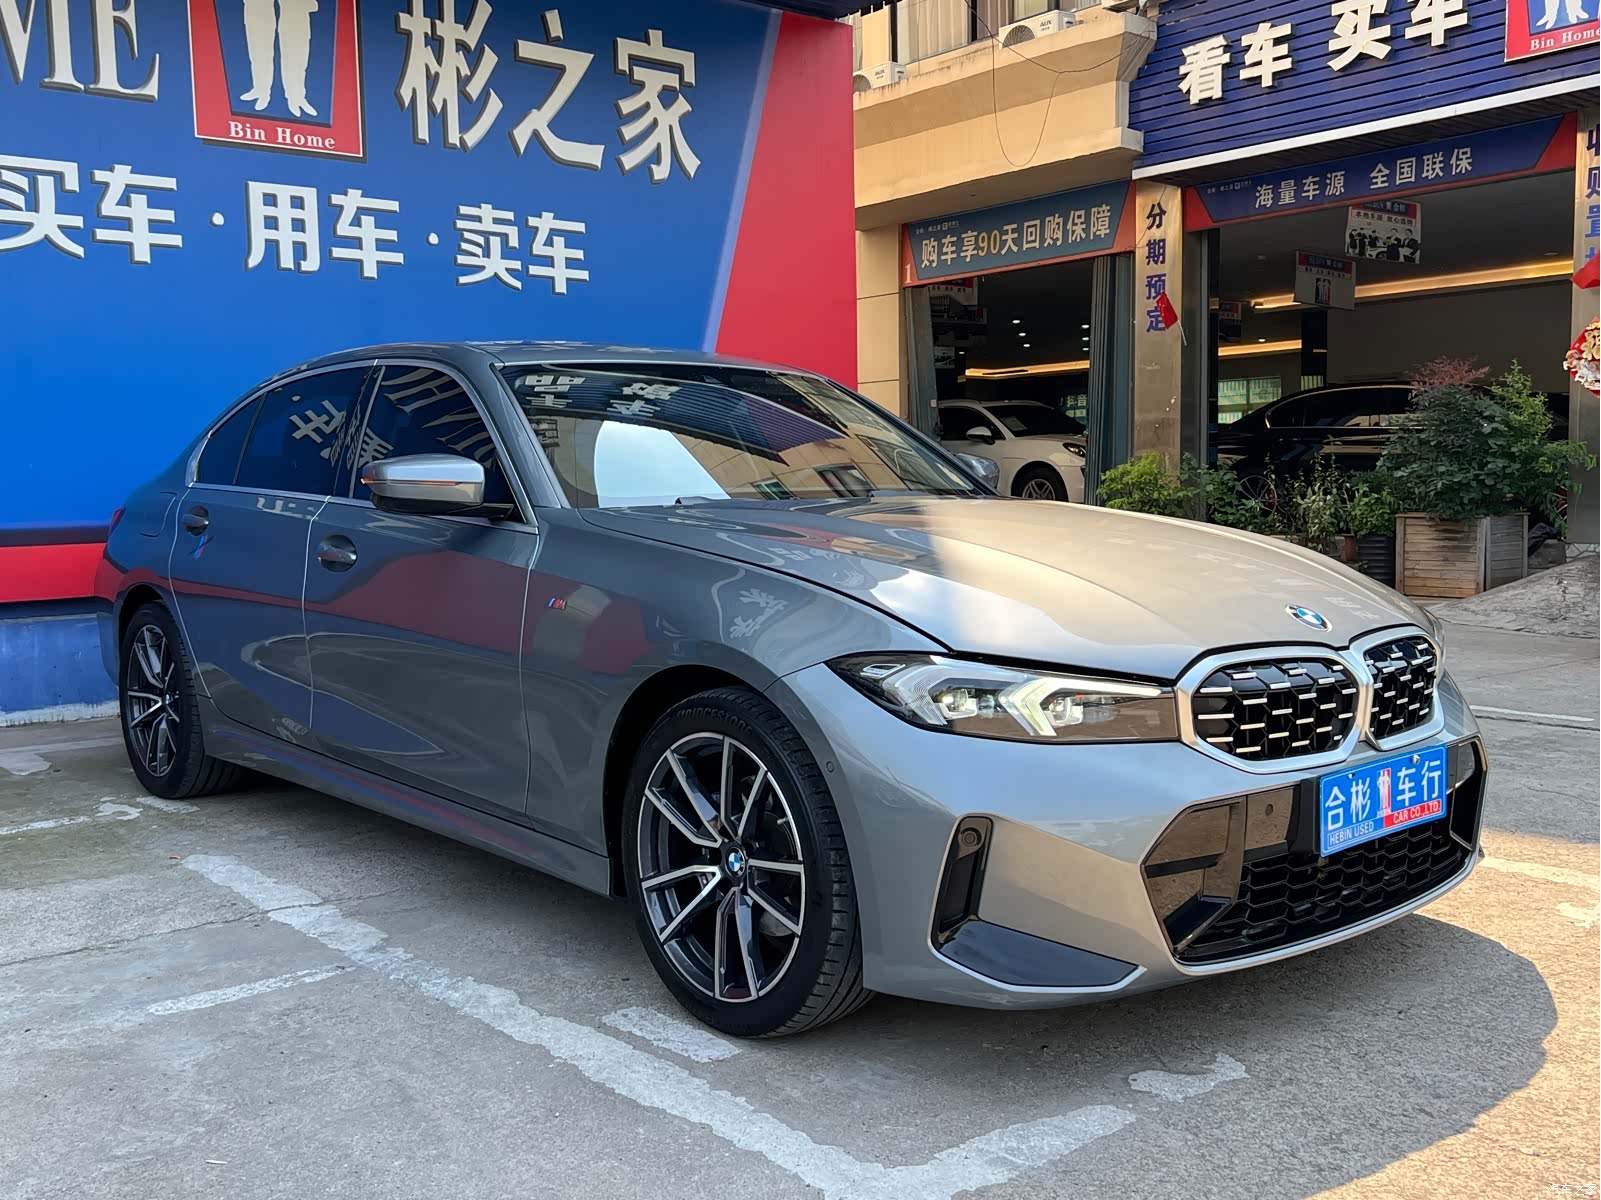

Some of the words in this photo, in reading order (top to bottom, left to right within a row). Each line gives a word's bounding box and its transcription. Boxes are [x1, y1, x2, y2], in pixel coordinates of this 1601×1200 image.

[1179, 22, 1292, 104] 看车
[1328, 0, 1468, 71] 买车
[1530, 37, 1554, 51] Bin
[1562, 27, 1600, 44] Home
[396, 0, 701, 182] 彬之家
[228, 121, 267, 142] Bin
[276, 127, 336, 149] Home
[1255, 170, 1346, 209] 海量车源
[1369, 146, 1474, 189] 全国联保
[921, 204, 1111, 269] 购车享90天回购保障
[904, 264, 912, 284] 1
[1325, 776, 1371, 831] 合彬
[1396, 760, 1442, 806] 车行
[1329, 829, 1352, 846] HEBIN
[1355, 821, 1374, 837] USED
[1393, 809, 1408, 824] CAR
